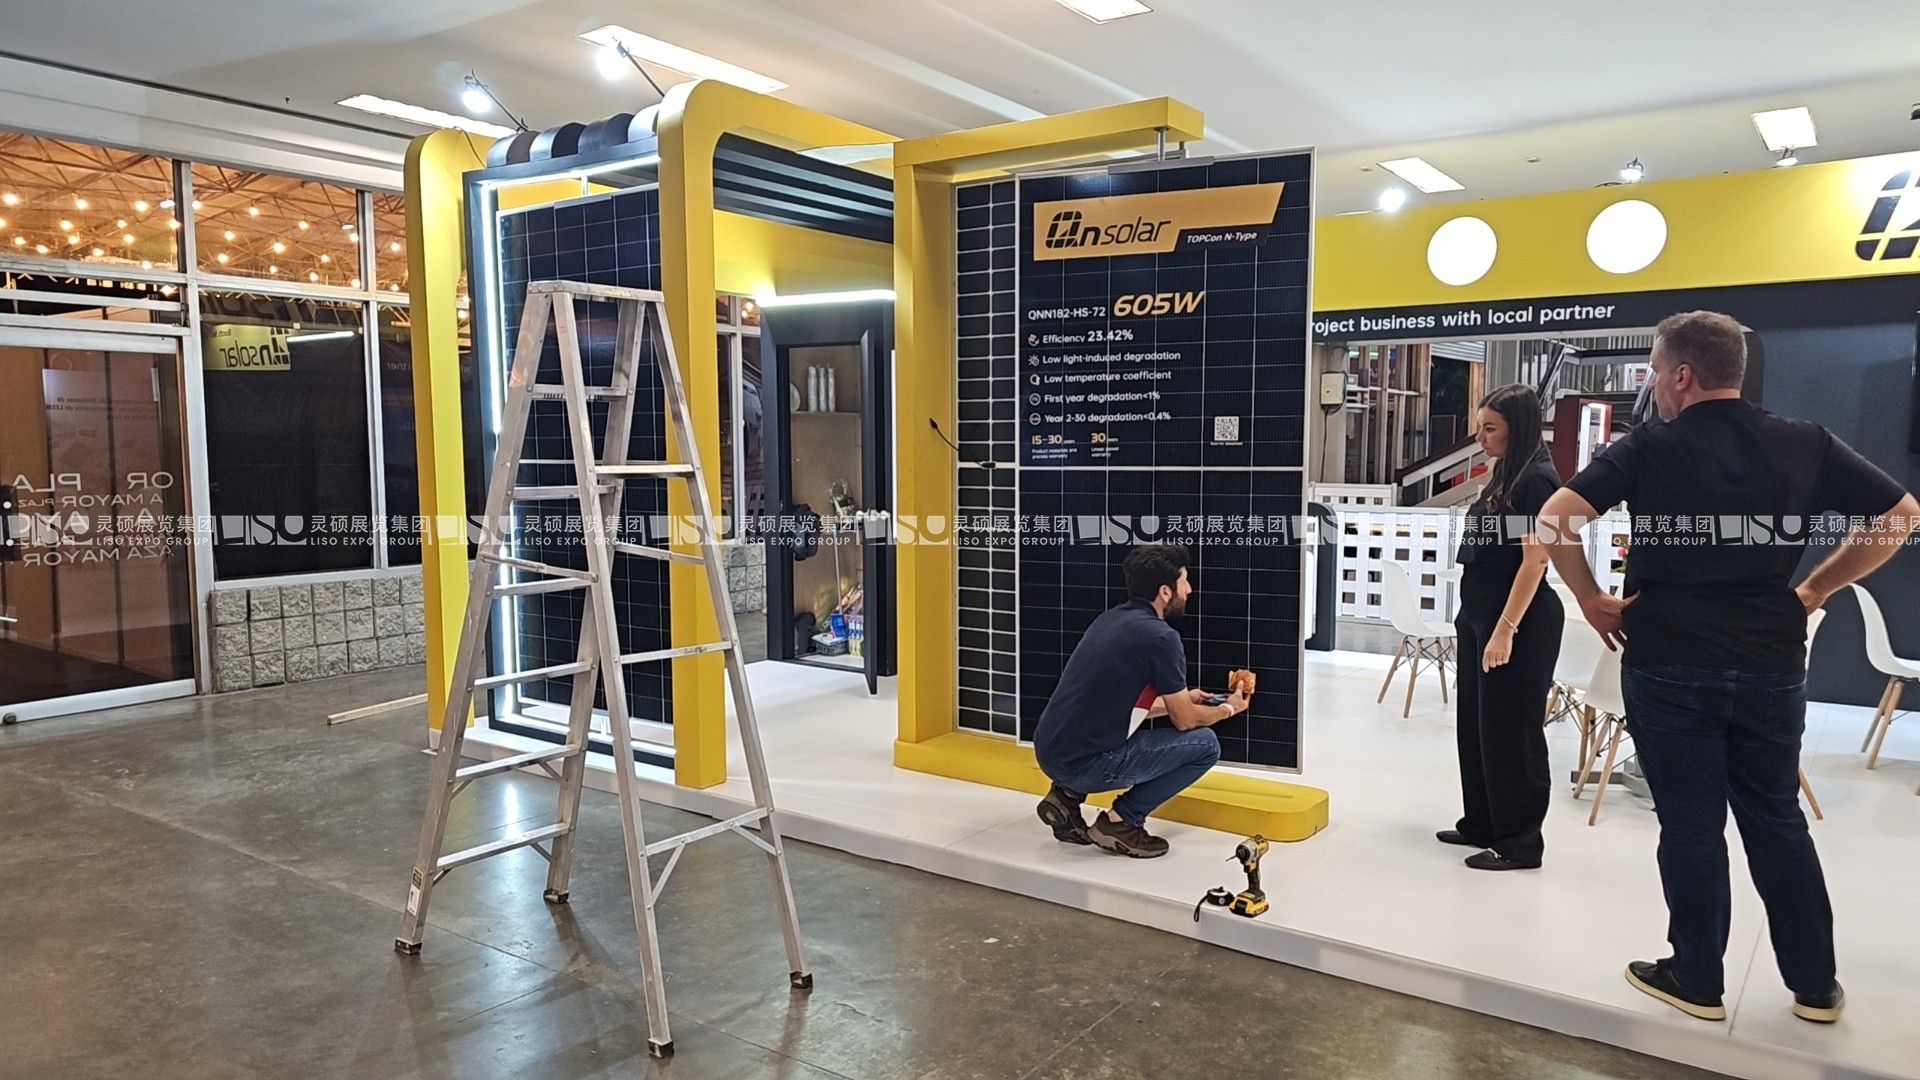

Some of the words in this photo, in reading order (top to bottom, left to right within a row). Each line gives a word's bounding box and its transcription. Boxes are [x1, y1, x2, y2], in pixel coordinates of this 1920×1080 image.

[1186, 234, 1222, 244] TOPCon
[1224, 232, 1257, 243] N-Type
[1028, 306, 1106, 320] QNN182-HS-72
[1113, 290, 1206, 317] 605W
[1360, 312, 1435, 332] business
[1442, 309, 1481, 327] with
[1488, 306, 1533, 325] local
[1540, 303, 1616, 325] partner
[1087, 329, 1134, 342] 23.42%
[1042, 356, 1061, 364] Low
[1063, 353, 1121, 365] light-induced
[1123, 351, 1181, 363] degradation
[1044, 374, 1063, 383] Low
[1065, 372, 1121, 384] temperature
[1123, 370, 1172, 381] coefficient
[1044, 394, 1063, 403] First
[1065, 395, 1085, 405] year
[1044, 414, 1063, 423] Year
[1066, 413, 1086, 423] 2-30
[1090, 432, 1106, 443] 30
